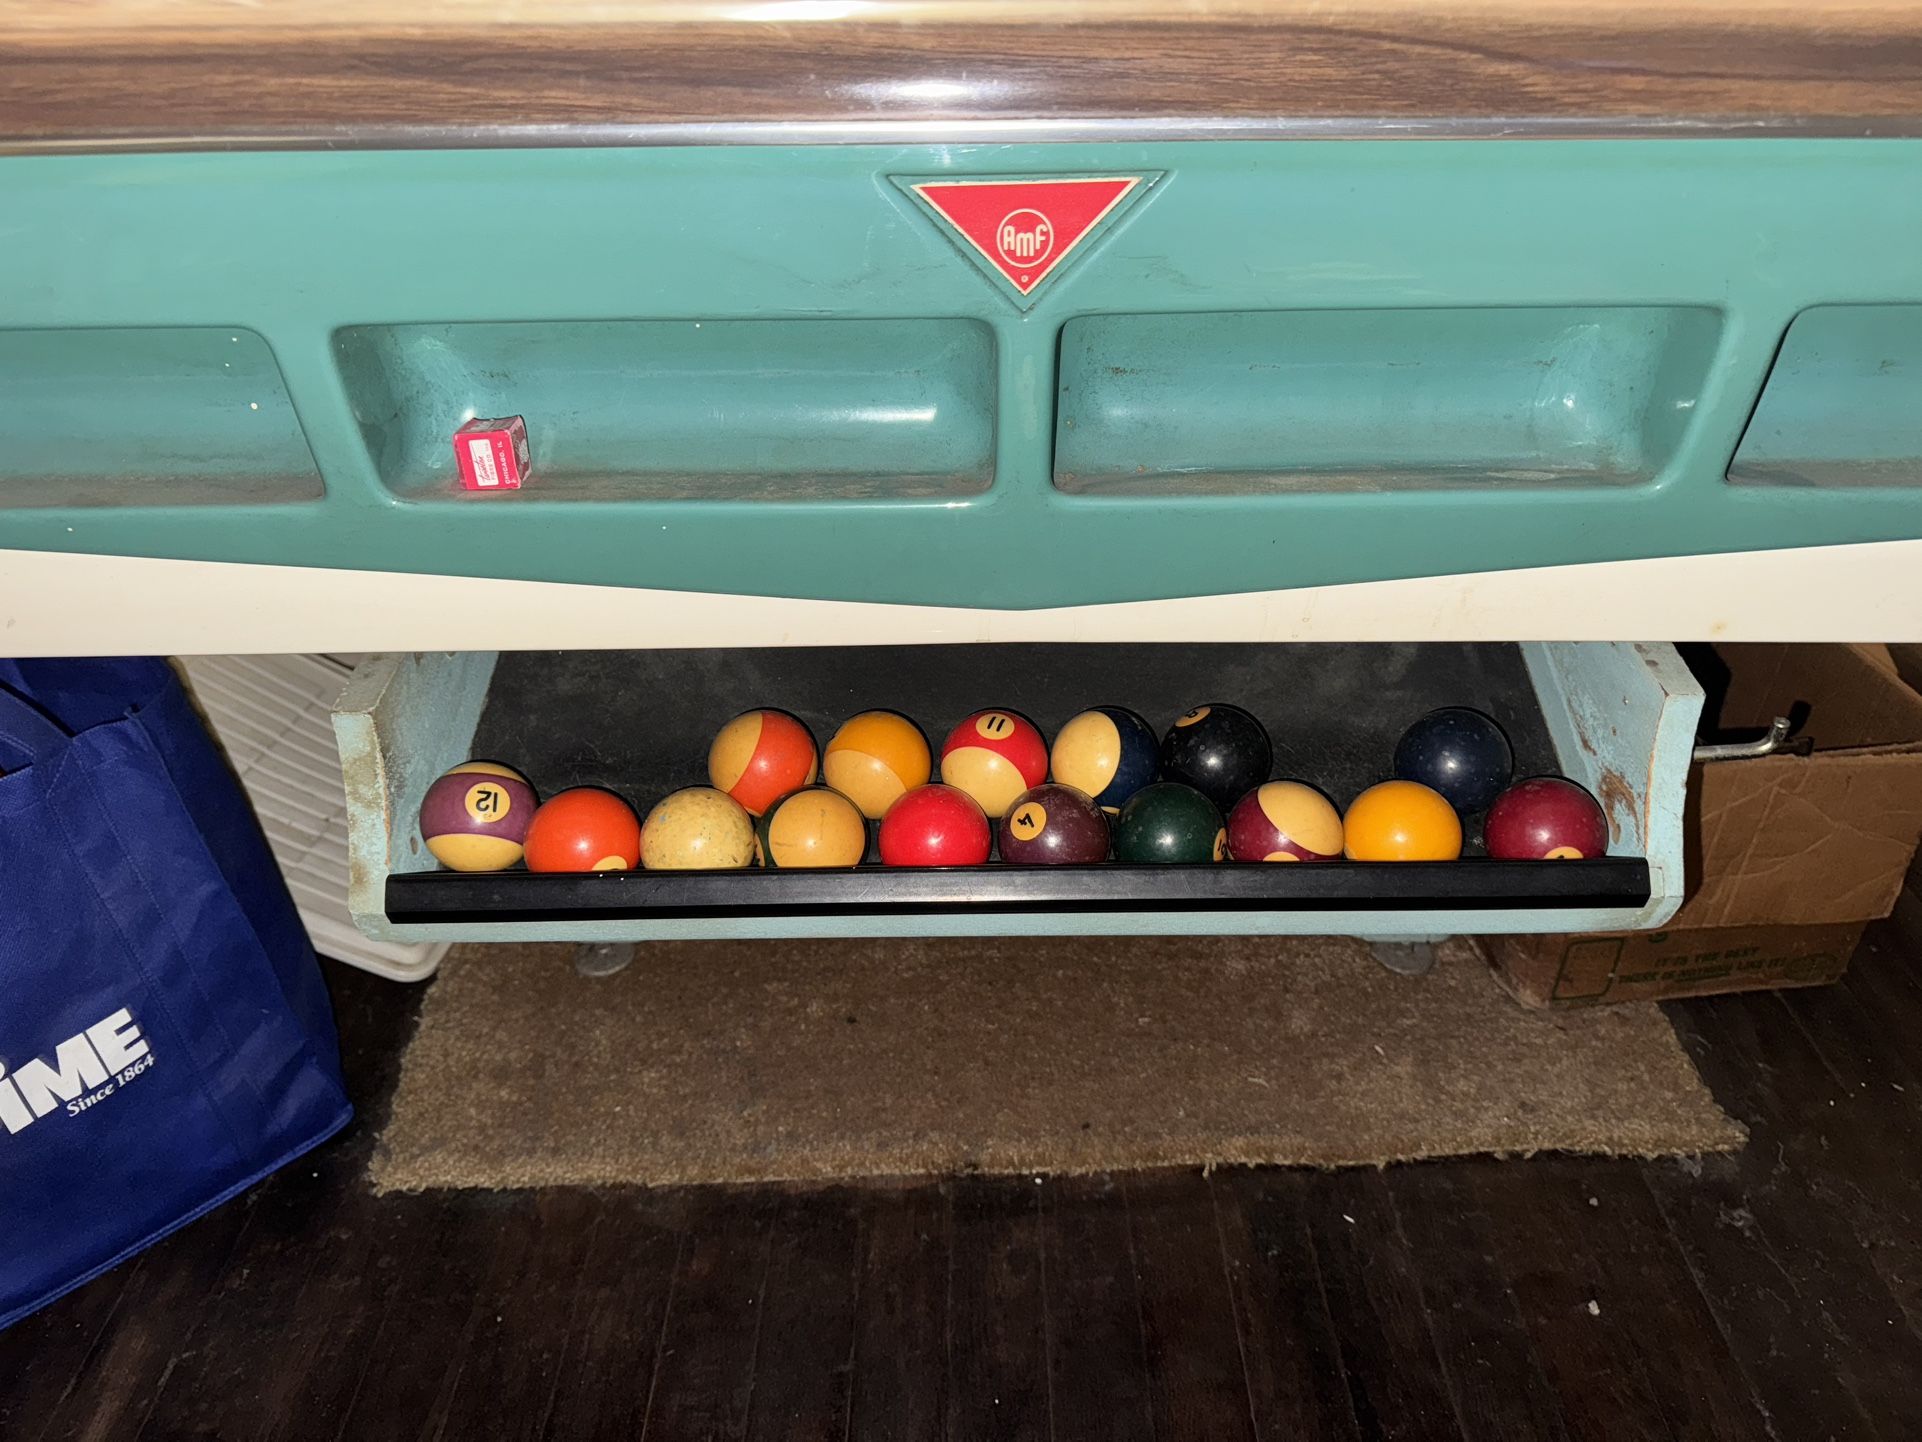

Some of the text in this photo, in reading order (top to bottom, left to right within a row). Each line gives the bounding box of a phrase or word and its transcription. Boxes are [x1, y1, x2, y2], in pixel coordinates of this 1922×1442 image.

[987, 716, 1006, 732] 11
[475, 790, 498, 813] 12
[66, 1053, 155, 1118] Since 1864
